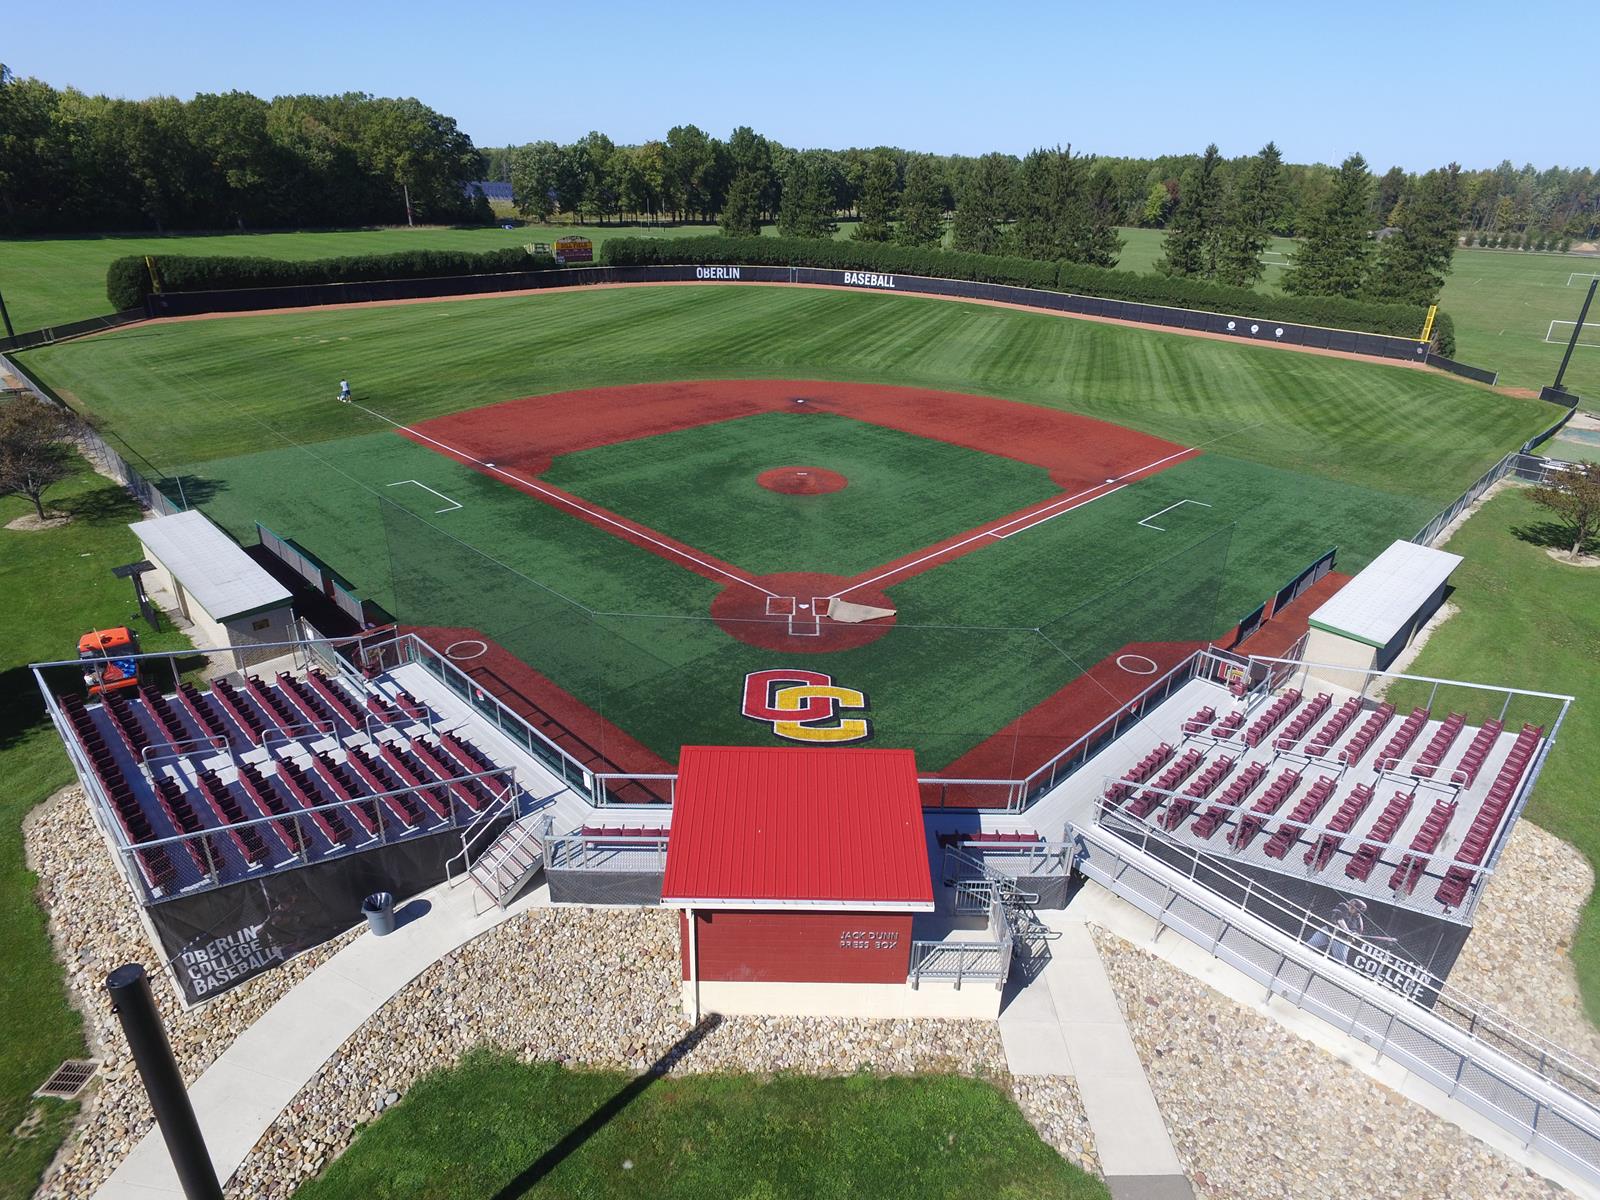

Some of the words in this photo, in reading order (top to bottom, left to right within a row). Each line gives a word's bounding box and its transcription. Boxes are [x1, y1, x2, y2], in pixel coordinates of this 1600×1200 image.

[696, 267, 740, 279] OBERLIN
[844, 272, 895, 288] BASEBALL
[181, 925, 257, 967] OBERLIN
[840, 931, 866, 940] JACK
[868, 931, 899, 940] DUNN
[840, 940, 869, 949] PRESS
[875, 940, 897, 949] BOX
[187, 939, 263, 980] COLLEGE
[192, 947, 277, 996] BASEBALL
[1353, 955, 1425, 997] COLLEGE
